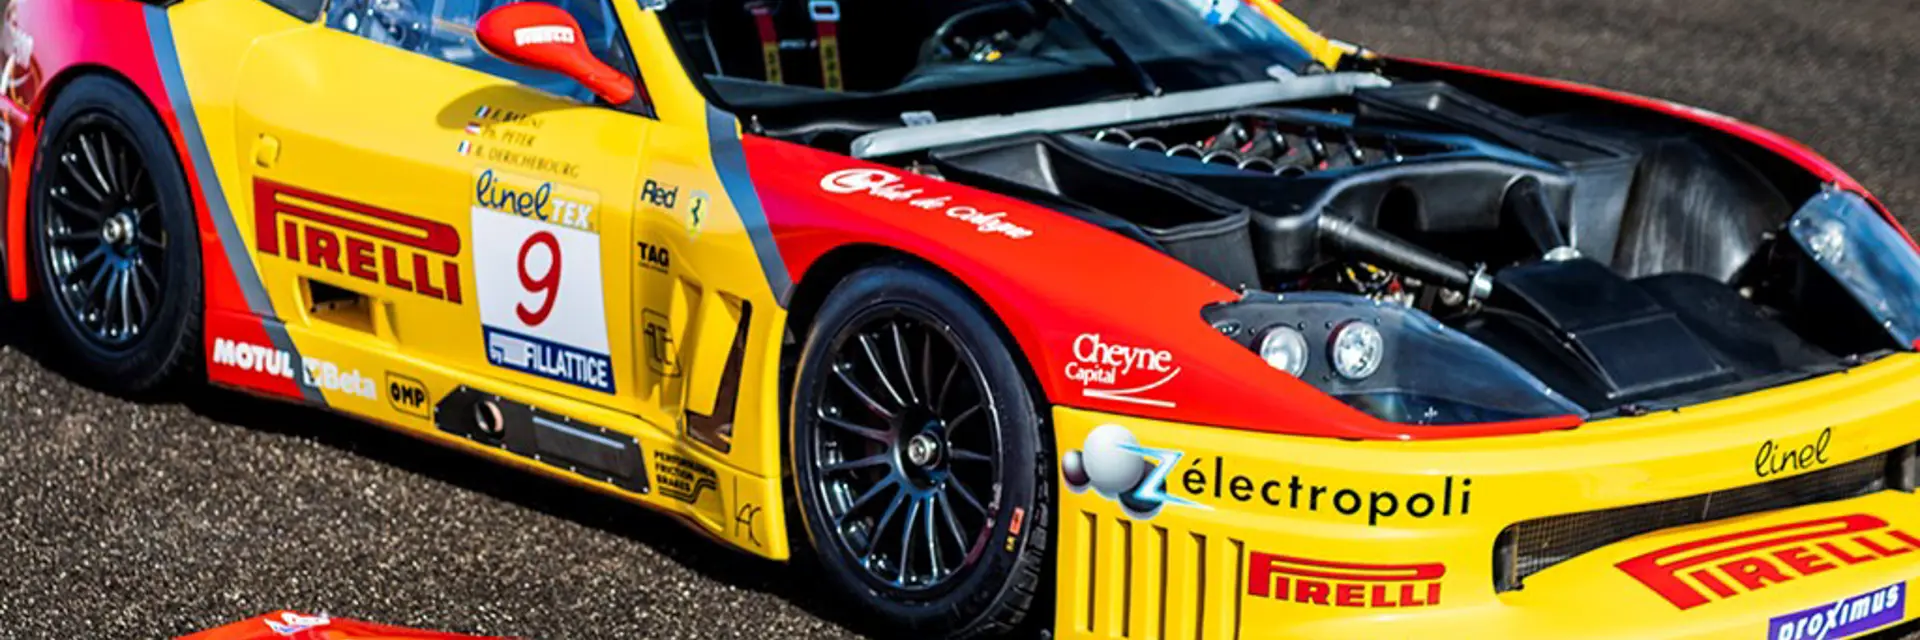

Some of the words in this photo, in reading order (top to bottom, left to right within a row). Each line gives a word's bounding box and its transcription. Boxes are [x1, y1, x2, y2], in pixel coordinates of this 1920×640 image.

[476, 168, 550, 221] linel
[551, 197, 593, 229] TEX
[641, 179, 678, 209] Red
[253, 176, 463, 305] PIRELLI
[637, 241, 670, 268] TAG
[516, 230, 562, 327] 9
[213, 338, 295, 379] MOTUL
[524, 341, 609, 388] FILLATTICE
[1065, 361, 1117, 386] Capital
[1073, 332, 1172, 376] Cheyne
[324, 361, 377, 401] Beta
[390, 382, 425, 408] OMP
[1755, 427, 1832, 478] linel
[1182, 456, 1472, 526] électropoli
[1247, 550, 1447, 608] PIRELLI
[1614, 514, 1920, 611] PIRELLI
